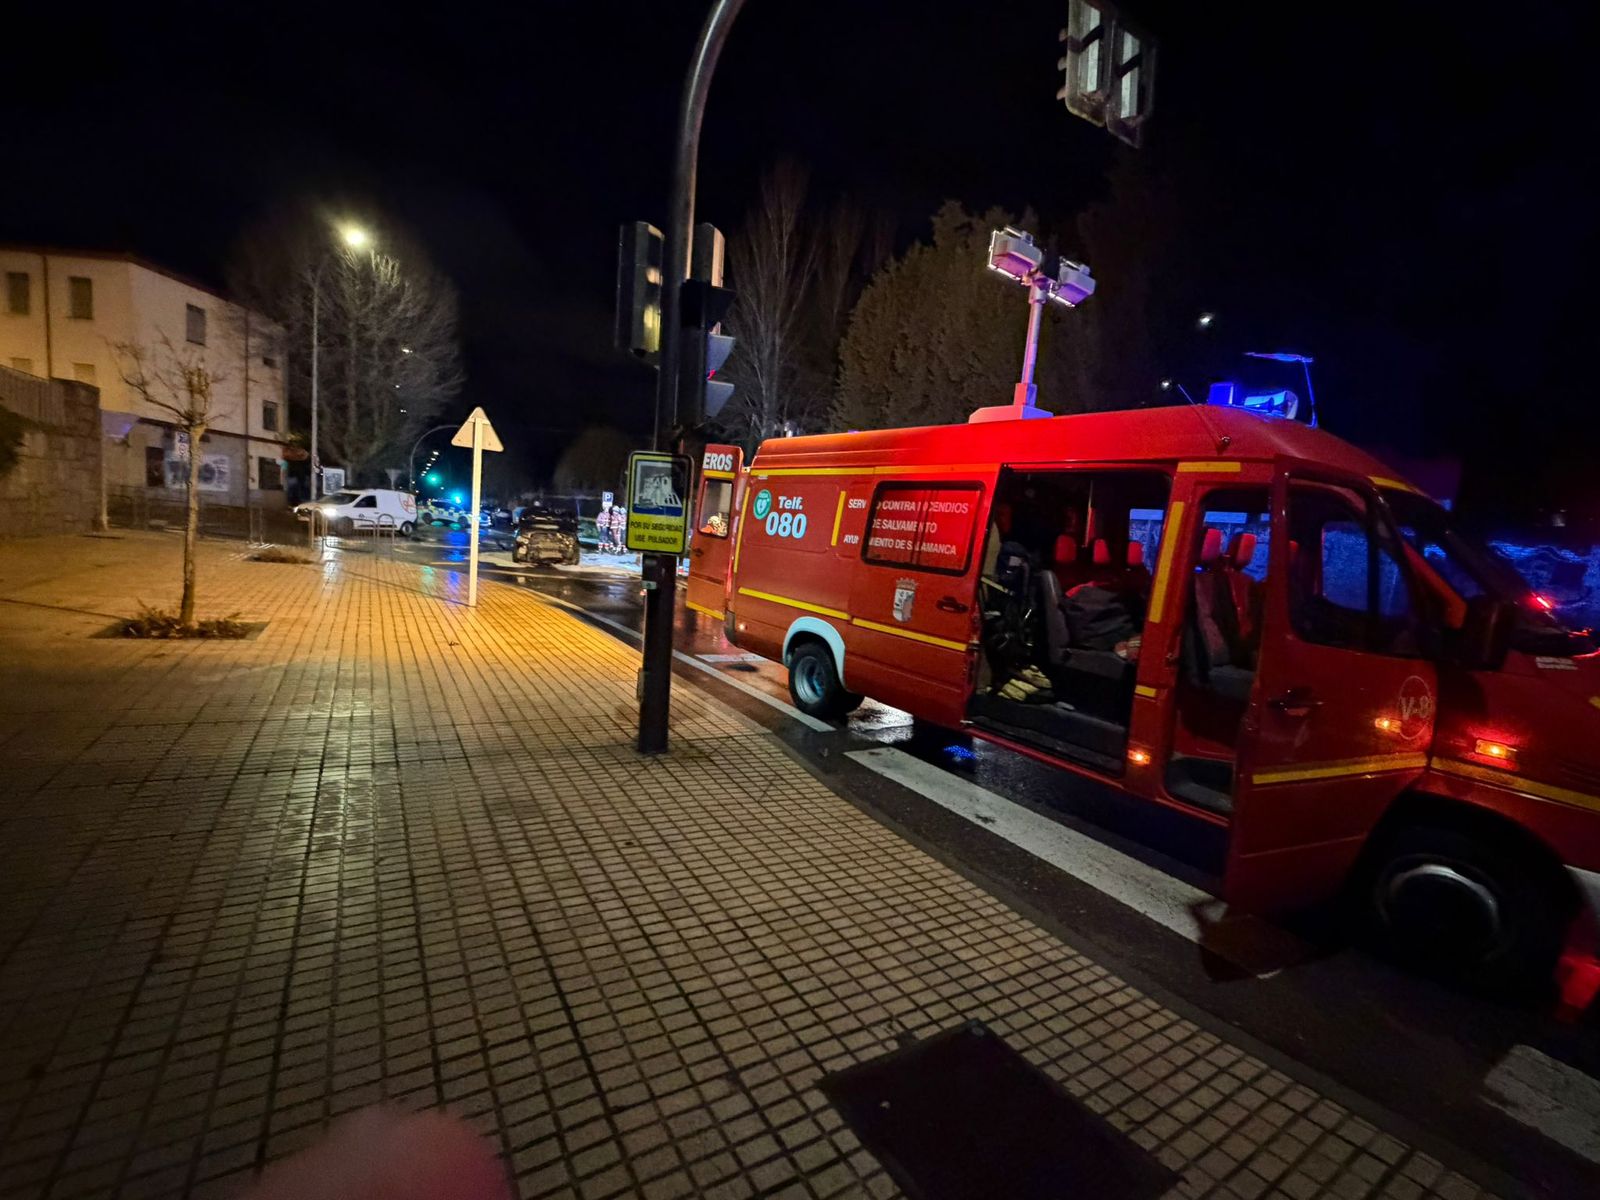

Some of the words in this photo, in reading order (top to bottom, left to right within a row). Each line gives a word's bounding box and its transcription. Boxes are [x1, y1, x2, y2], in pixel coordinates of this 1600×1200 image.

[778, 496, 803, 510] Telf.
[882, 500, 916, 511] CONTRA
[765, 511, 807, 539] 080
[881, 519, 938, 534] SALVAMENTO
[895, 539, 906, 550] DE
